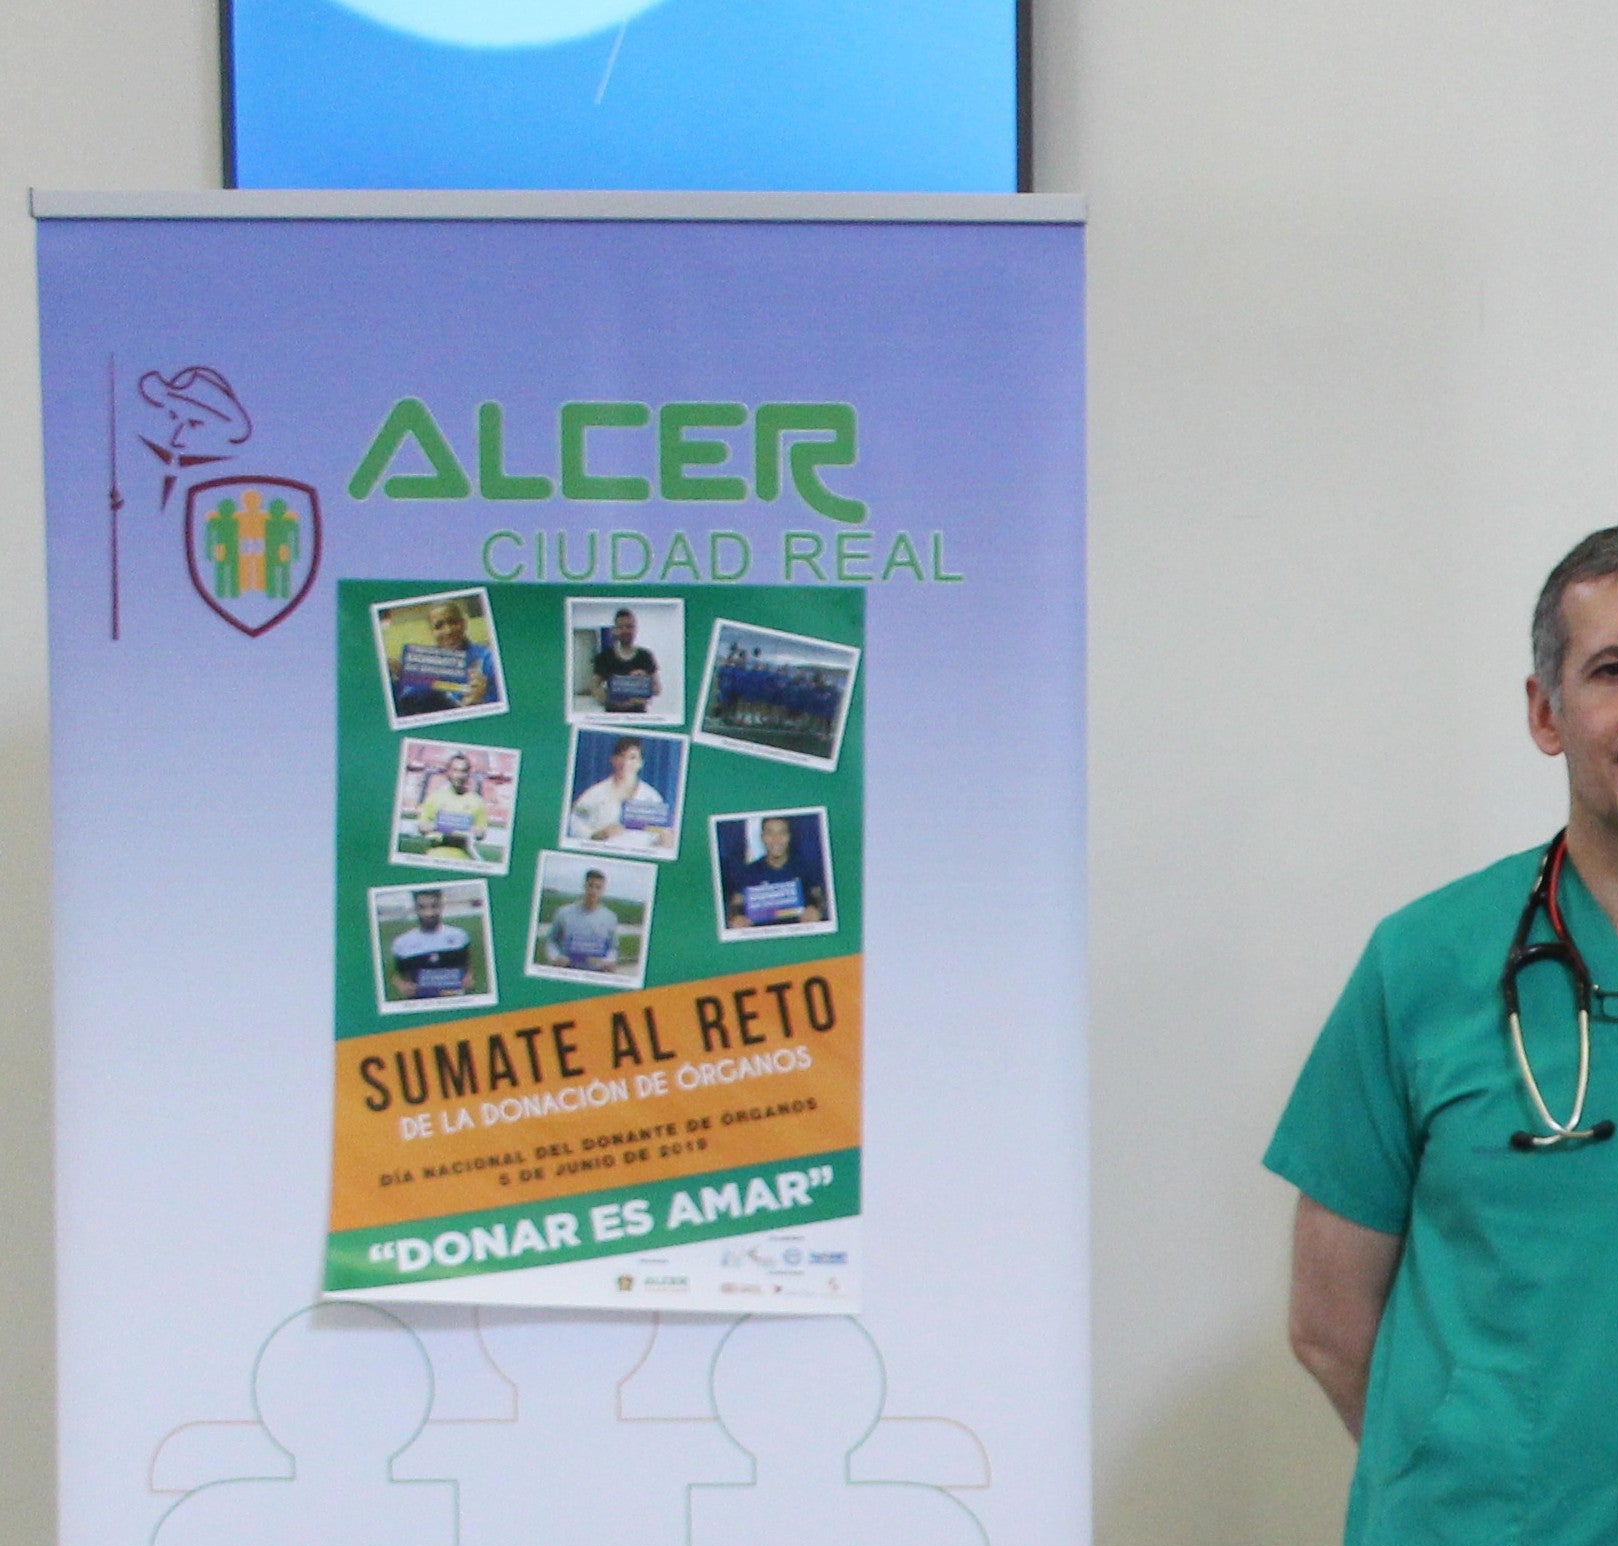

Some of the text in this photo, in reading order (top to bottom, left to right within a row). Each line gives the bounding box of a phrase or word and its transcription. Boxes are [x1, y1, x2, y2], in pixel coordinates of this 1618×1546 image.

[348, 397, 868, 525] ALCER
[481, 530, 966, 584] CIUDAD REAL
[359, 975, 838, 1113] SUMATE AL RETO
[400, 1045, 813, 1142] DE LA DONACIÓN DE ÓRGANOS
[380, 1167, 414, 1187] DÍA
[421, 1151, 525, 1181] NACIONAL
[535, 1141, 574, 1160] DEL
[582, 1121, 678, 1151] DONANTE
[686, 1116, 711, 1133] DE
[519, 1167, 547, 1183] DE
[555, 1154, 614, 1179] JUNIO
[622, 1147, 649, 1164] DE
[590, 1199, 654, 1242] ES
